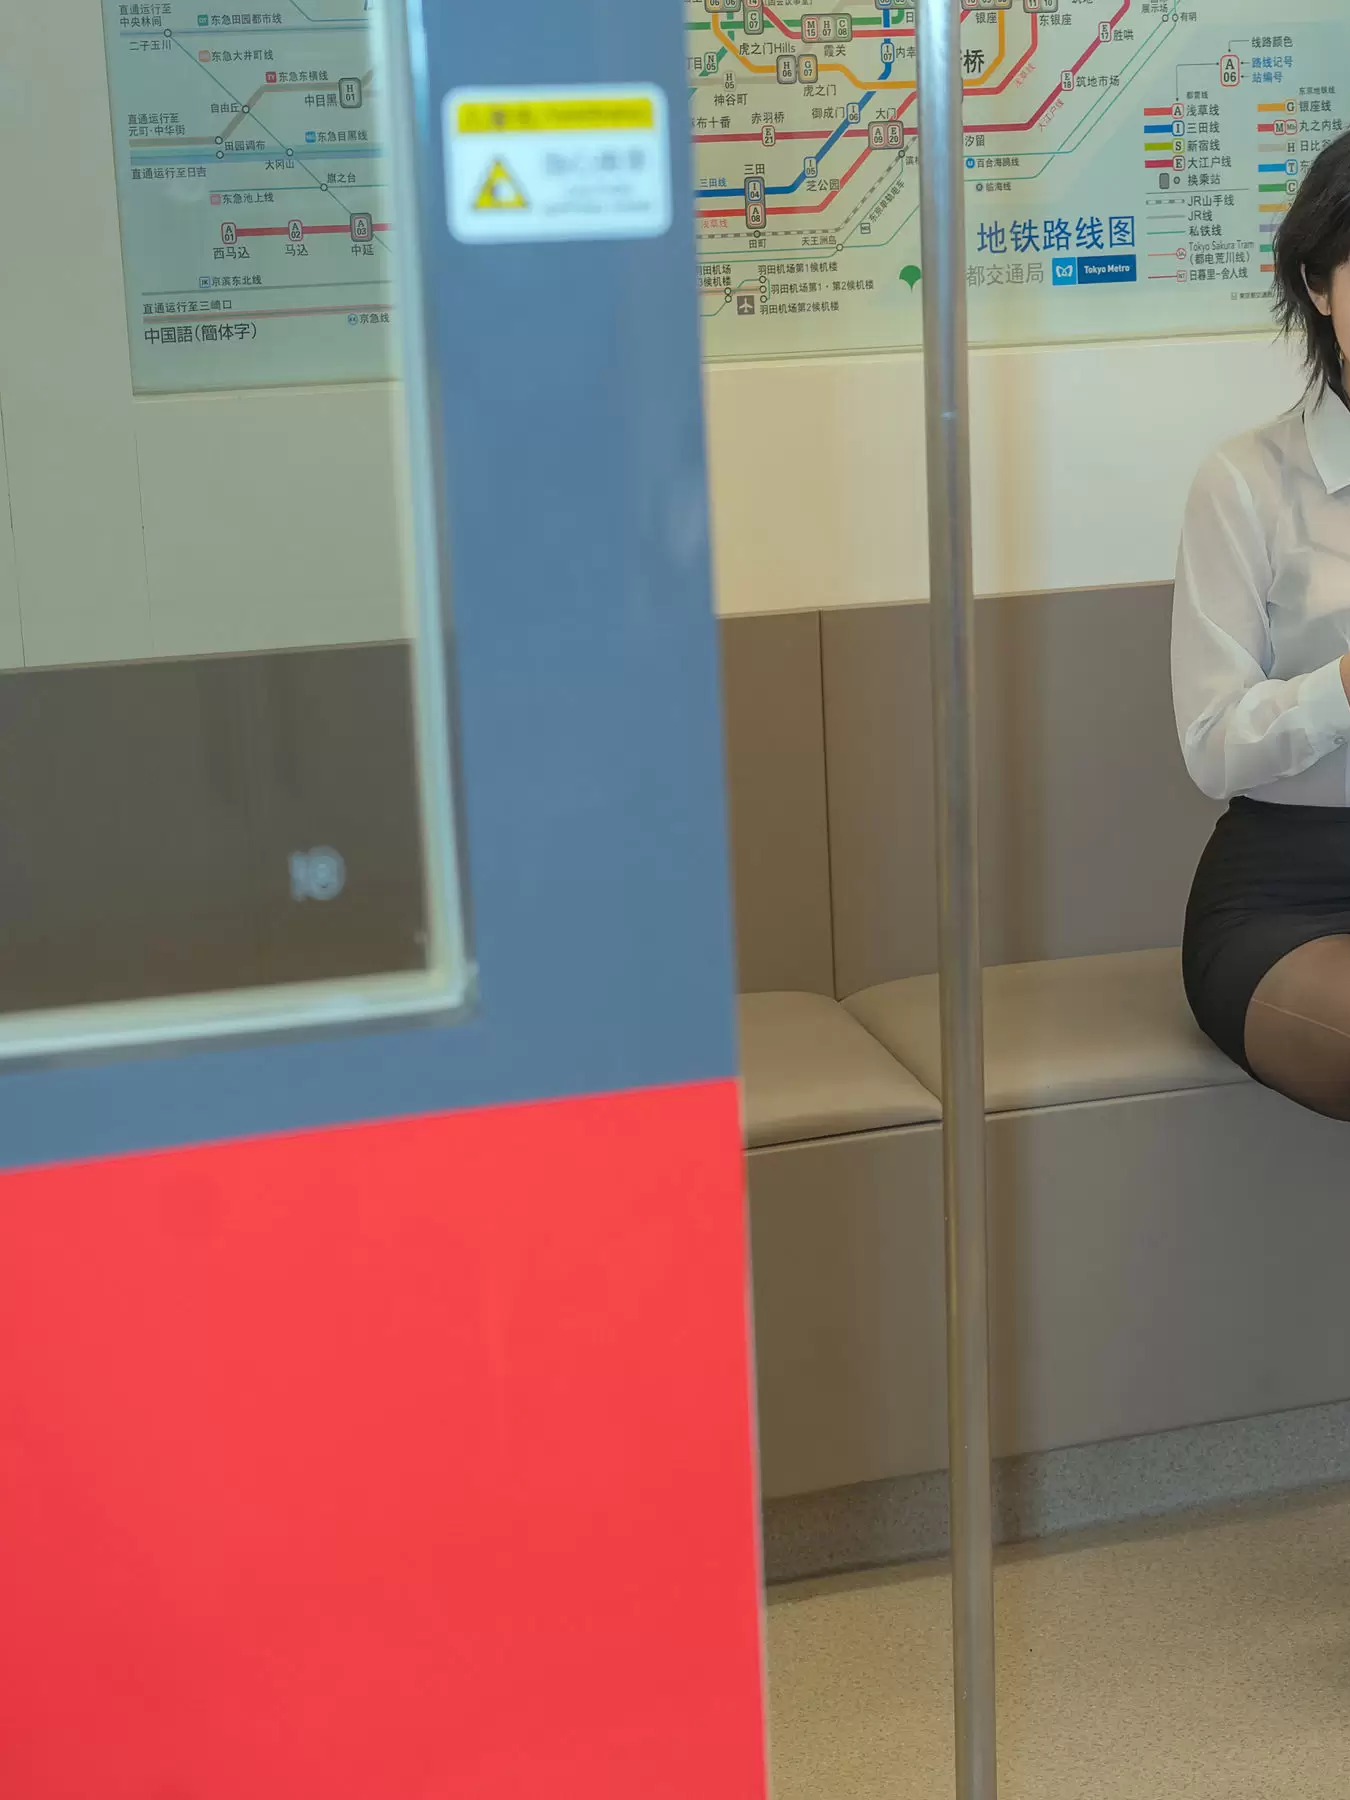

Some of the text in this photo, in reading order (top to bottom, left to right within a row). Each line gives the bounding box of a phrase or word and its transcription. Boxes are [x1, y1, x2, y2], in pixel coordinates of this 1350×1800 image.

[119, 4, 172, 16] 直通运行至
[211, 14, 282, 25] 东急田园都市线
[976, 12, 997, 24] 银座
[1040, 14, 1072, 26] 东银座
[1180, 12, 1197, 22] 有明
[129, 40, 172, 51] 二子玉川
[1252, 36, 1293, 48] 线路颜色
[739, 42, 796, 56] 虎之门Hills
[212, 50, 274, 62] 东急大井町线
[1252, 56, 1293, 68] 路线记号
[1225, 59, 1235, 70] A
[278, 70, 328, 82] 东急东横线
[1076, 76, 1120, 88] 筑地市场
[1223, 72, 1236, 82] 06
[1252, 72, 1283, 83] 站编号
[347, 84, 354, 93] H
[803, 85, 836, 97] 虎之门
[304, 94, 338, 108] 中目黑
[714, 94, 748, 106] 神谷町
[1286, 100, 1332, 112] G 银座线
[210, 103, 240, 113] 自由丘
[812, 107, 845, 119] 御成门
[876, 108, 896, 120] 大门
[1174, 104, 1220, 117] A 浅草线
[128, 113, 179, 125] 直通运行至
[751, 112, 784, 124] 赤羽桥
[1176, 122, 1220, 134] I 三田线
[1275, 123, 1284, 132] M
[1300, 119, 1343, 132] 丸之内线
[318, 130, 368, 142] 东急目黑线
[965, 135, 985, 147] 汐留
[224, 140, 266, 151] 田园调布
[1175, 140, 1220, 152] S 新宿线
[1287, 143, 1295, 152] H
[265, 160, 294, 170] 大冈山
[1176, 156, 1231, 169] E 大江户线
[1288, 163, 1295, 172] T
[131, 166, 206, 180] 直通运行至日吉
[744, 164, 765, 175] 三田
[327, 172, 356, 183] 旗之台
[806, 179, 840, 192] 芝公园
[1289, 183, 1295, 192] C
[222, 192, 274, 205] 东急池上线
[1188, 195, 1234, 207] JR山手线
[1188, 210, 1213, 222] JR线
[976, 216, 1135, 254] 地铁路线图
[1189, 225, 1222, 237] 私铁线
[352, 244, 374, 256] 中延
[749, 239, 766, 249] 田町
[1189, 240, 1254, 253] Tokyo Sakura Tram
[1084, 264, 1130, 275] Tokyo Metro
[212, 275, 262, 286] 京滨东北线
[360, 313, 390, 324] 京急线
